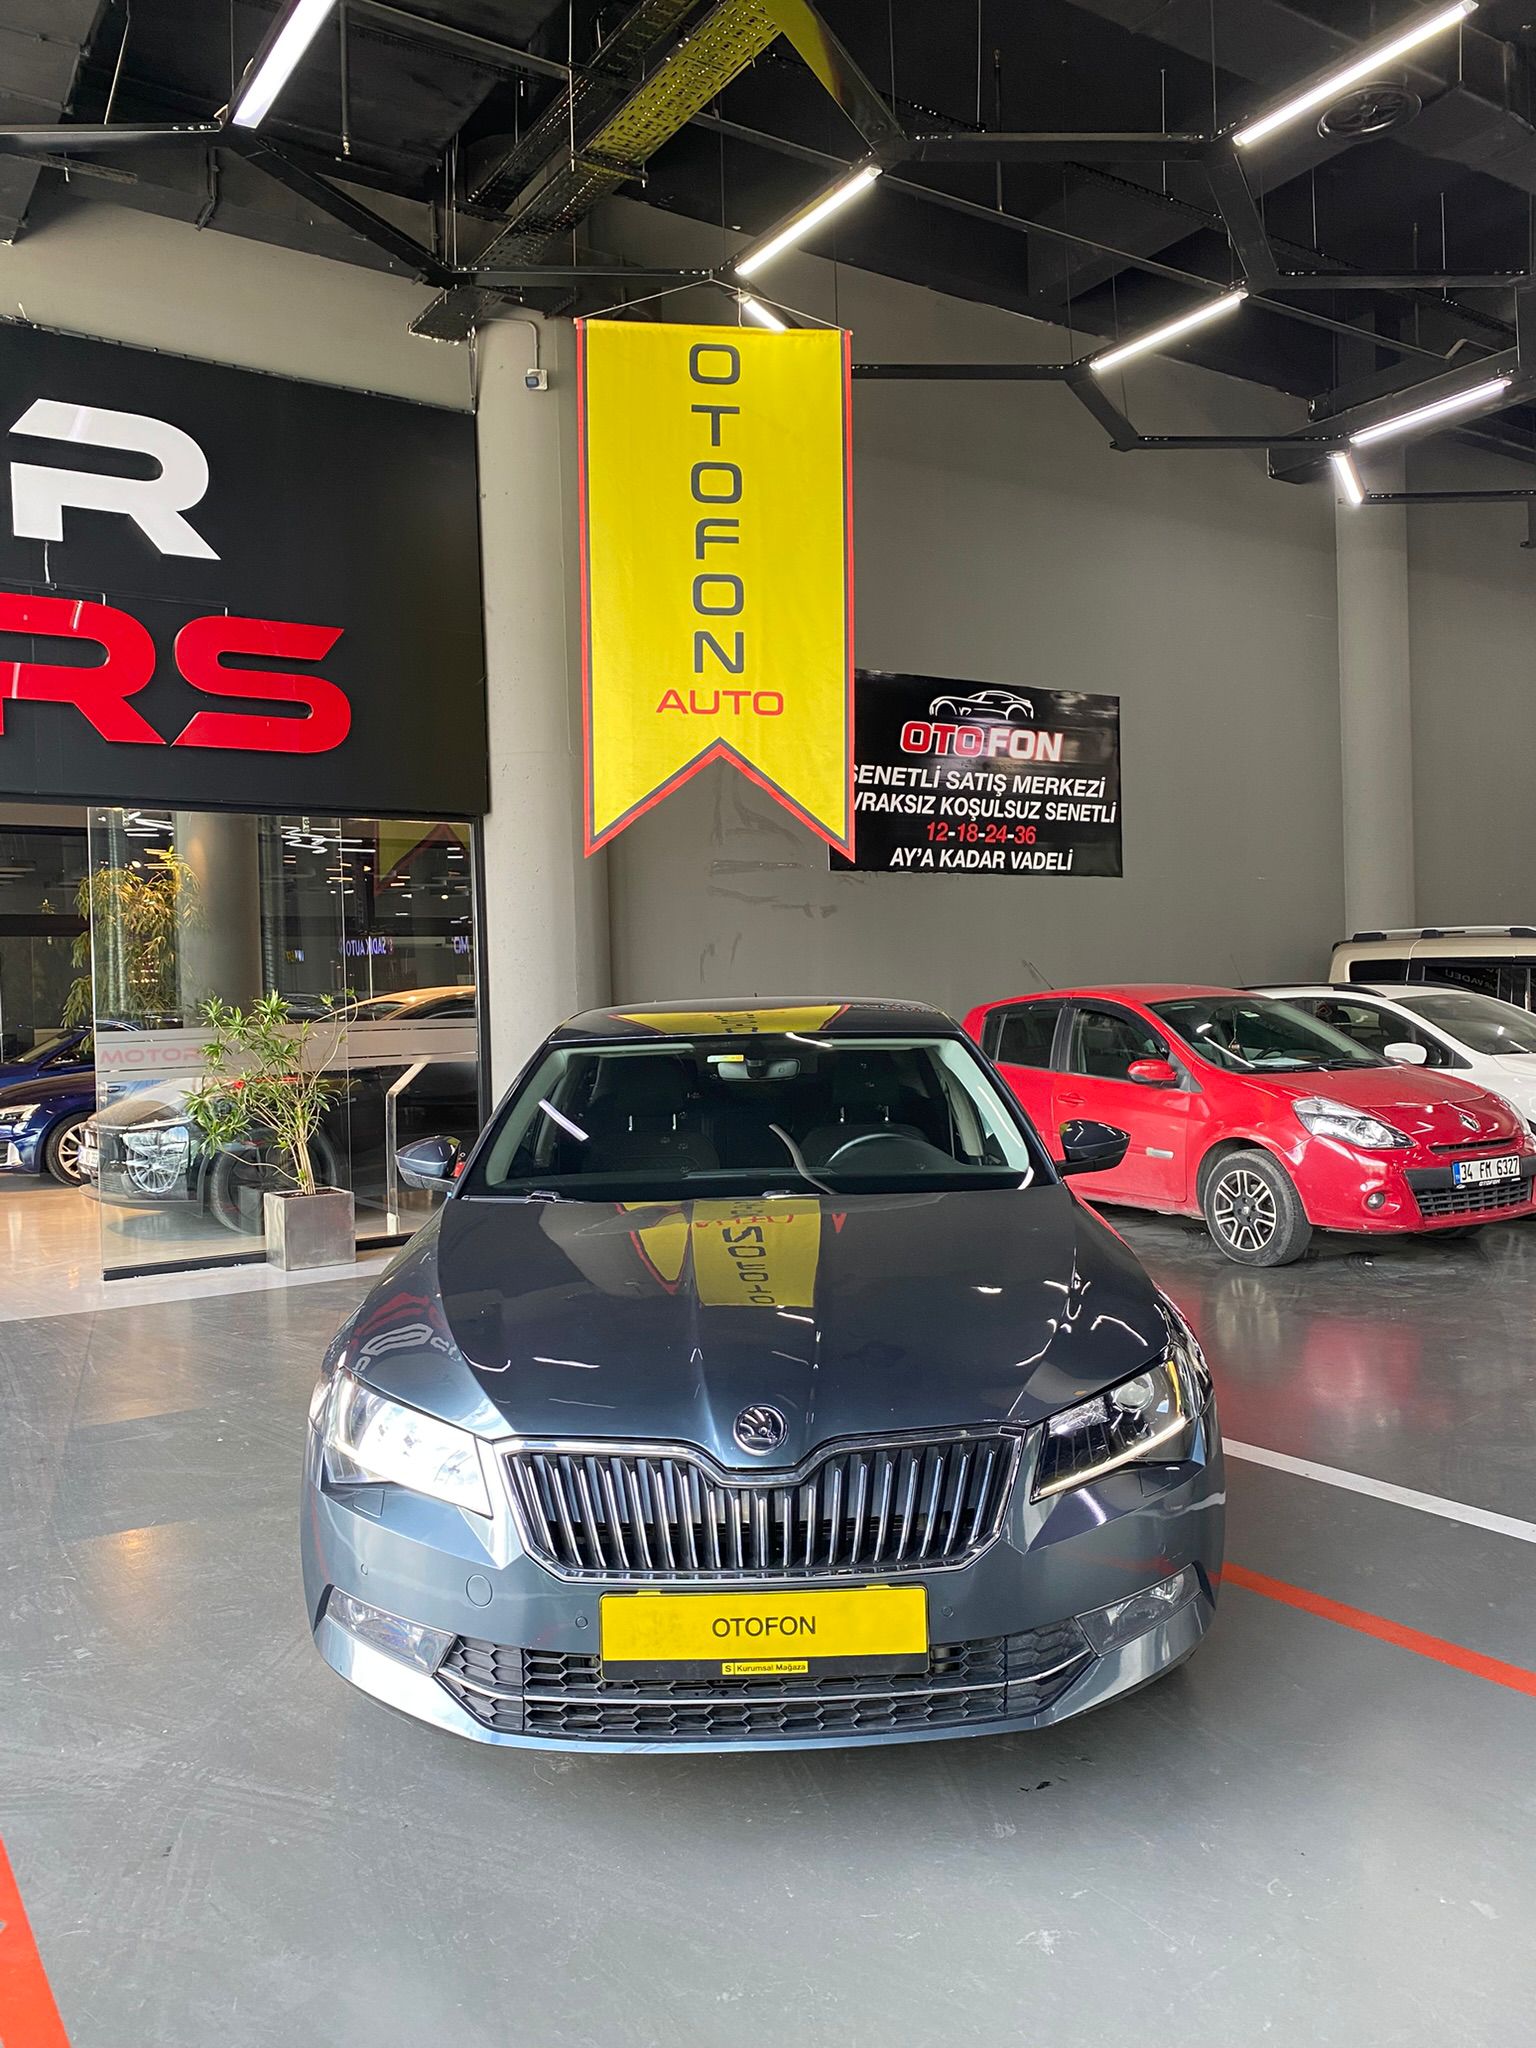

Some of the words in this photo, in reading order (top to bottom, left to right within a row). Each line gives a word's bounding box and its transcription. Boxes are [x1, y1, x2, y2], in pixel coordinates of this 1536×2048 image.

[9, 398, 221, 560] R
[689, 343, 745, 673] OTOFON
[656, 689, 784, 716] AUTO
[900, 721, 1064, 762] OTOFON
[946, 770, 1007, 796] SATIŞ
[1012, 775, 1106, 798] MERKEZİ
[940, 797, 1041, 822] KOŞULSUZ
[1044, 801, 1117, 823] SENETLİ
[926, 822, 1037, 845] 12-18-24-36
[939, 850, 1006, 869] KADAR
[1010, 849, 1073, 871] VADELİ
[1461, 1163, 1473, 1180] 34
[1497, 1158, 1517, 1175] 6327
[712, 1616, 816, 1637] OTOFON
[776, 1663, 806, 1671] Mağaza
